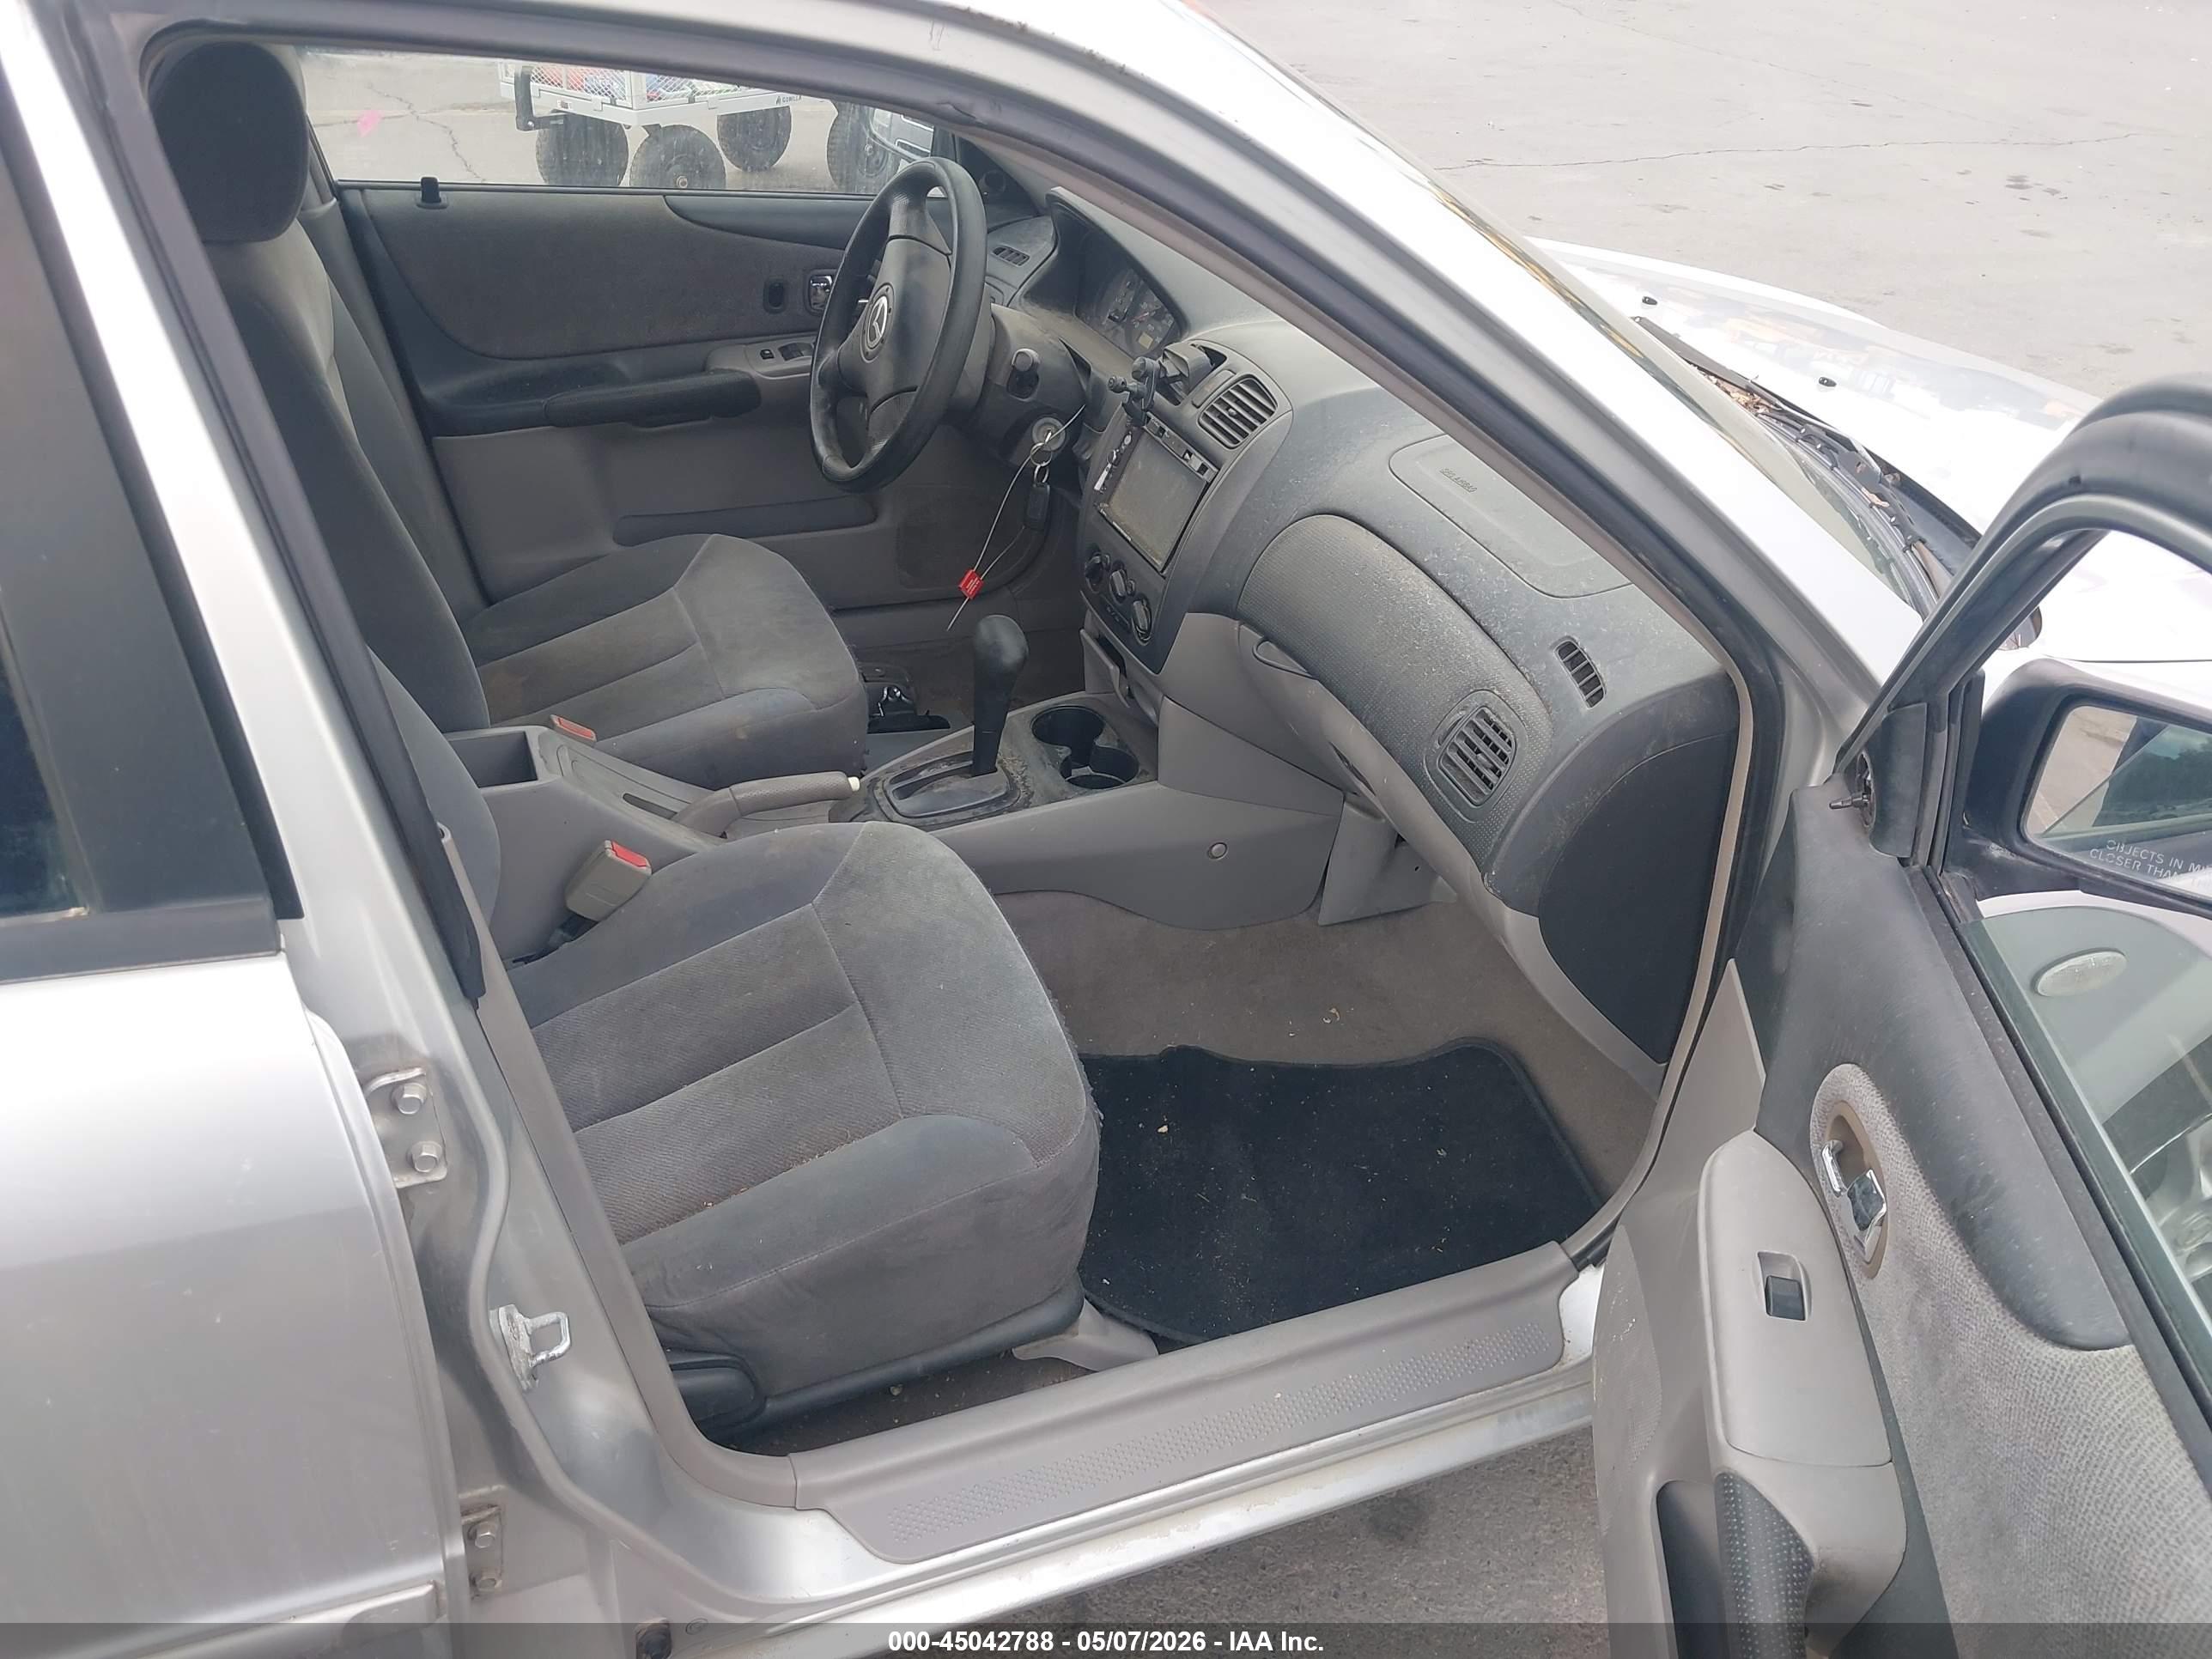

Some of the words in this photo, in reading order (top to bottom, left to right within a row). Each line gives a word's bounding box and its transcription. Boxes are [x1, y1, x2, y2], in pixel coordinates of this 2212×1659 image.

[2089, 848, 2142, 871] CLOSER
[2106, 839, 2165, 865] OBJECTS
[2168, 856, 2184, 870] IN
